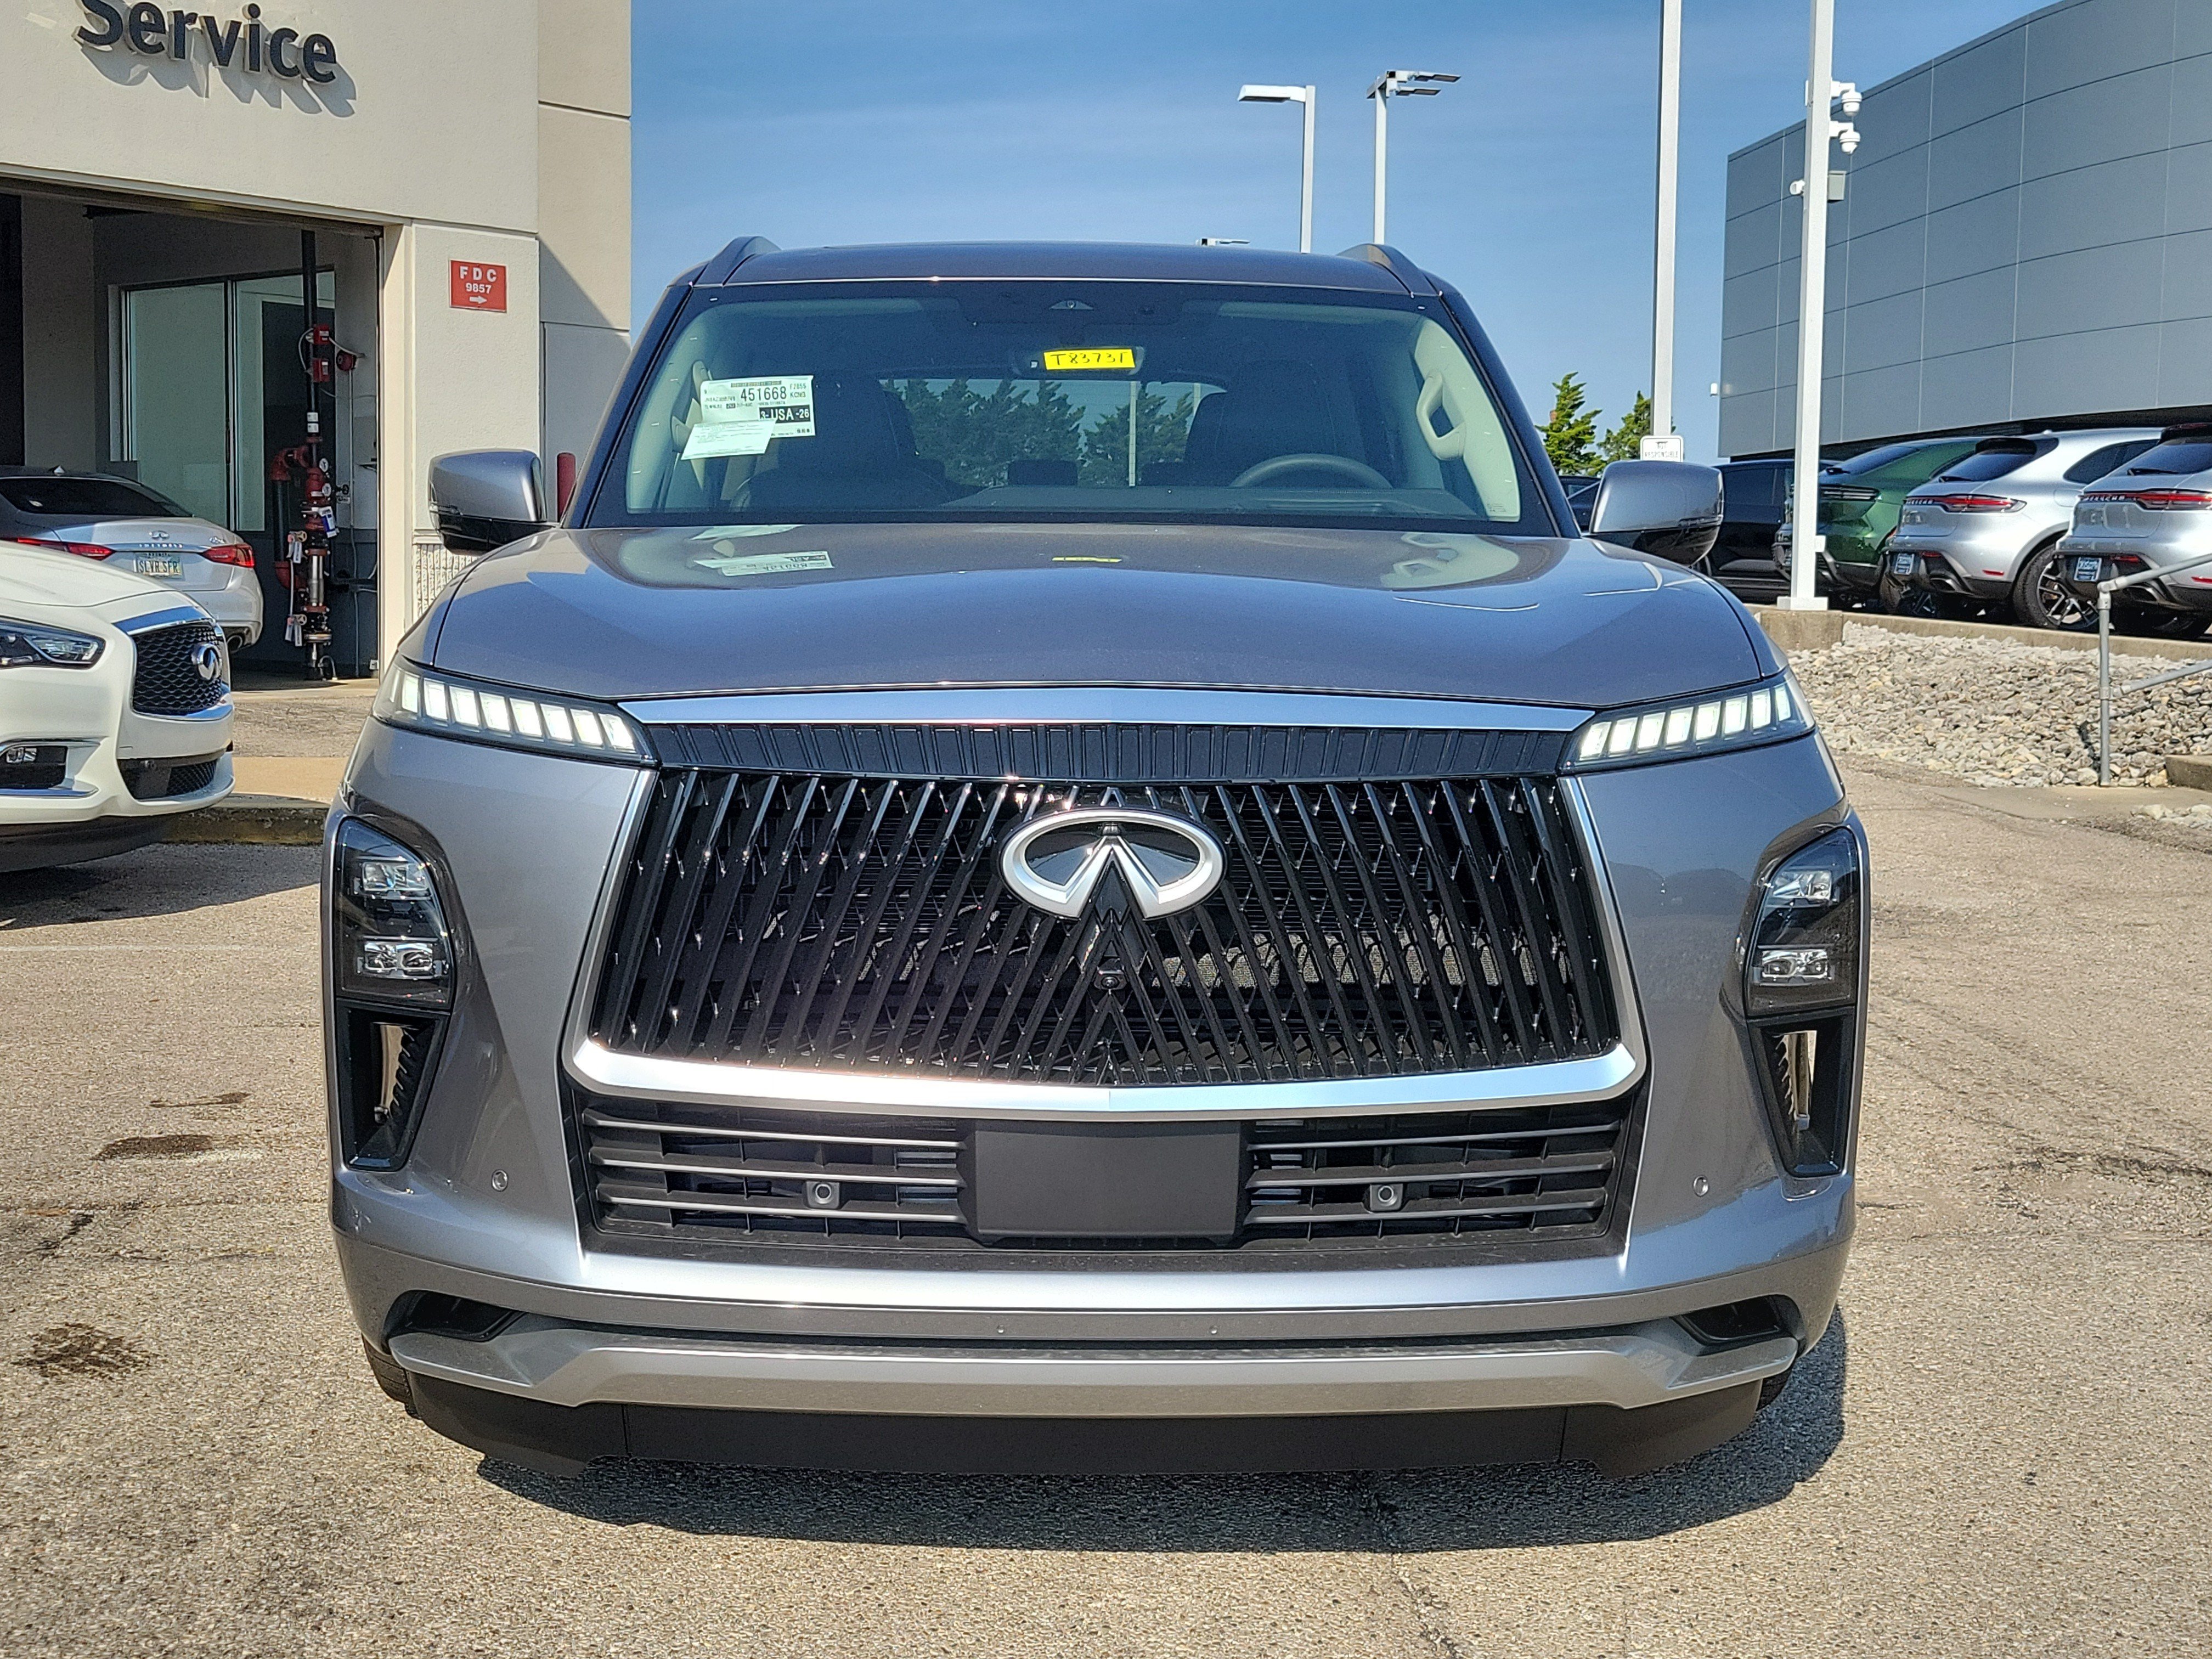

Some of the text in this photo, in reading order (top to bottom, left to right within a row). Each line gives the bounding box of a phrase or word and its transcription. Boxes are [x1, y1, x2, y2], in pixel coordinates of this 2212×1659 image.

[76, 0, 337, 83] Service
[465, 283, 492, 294] 9857
[741, 386, 787, 402] 451668
